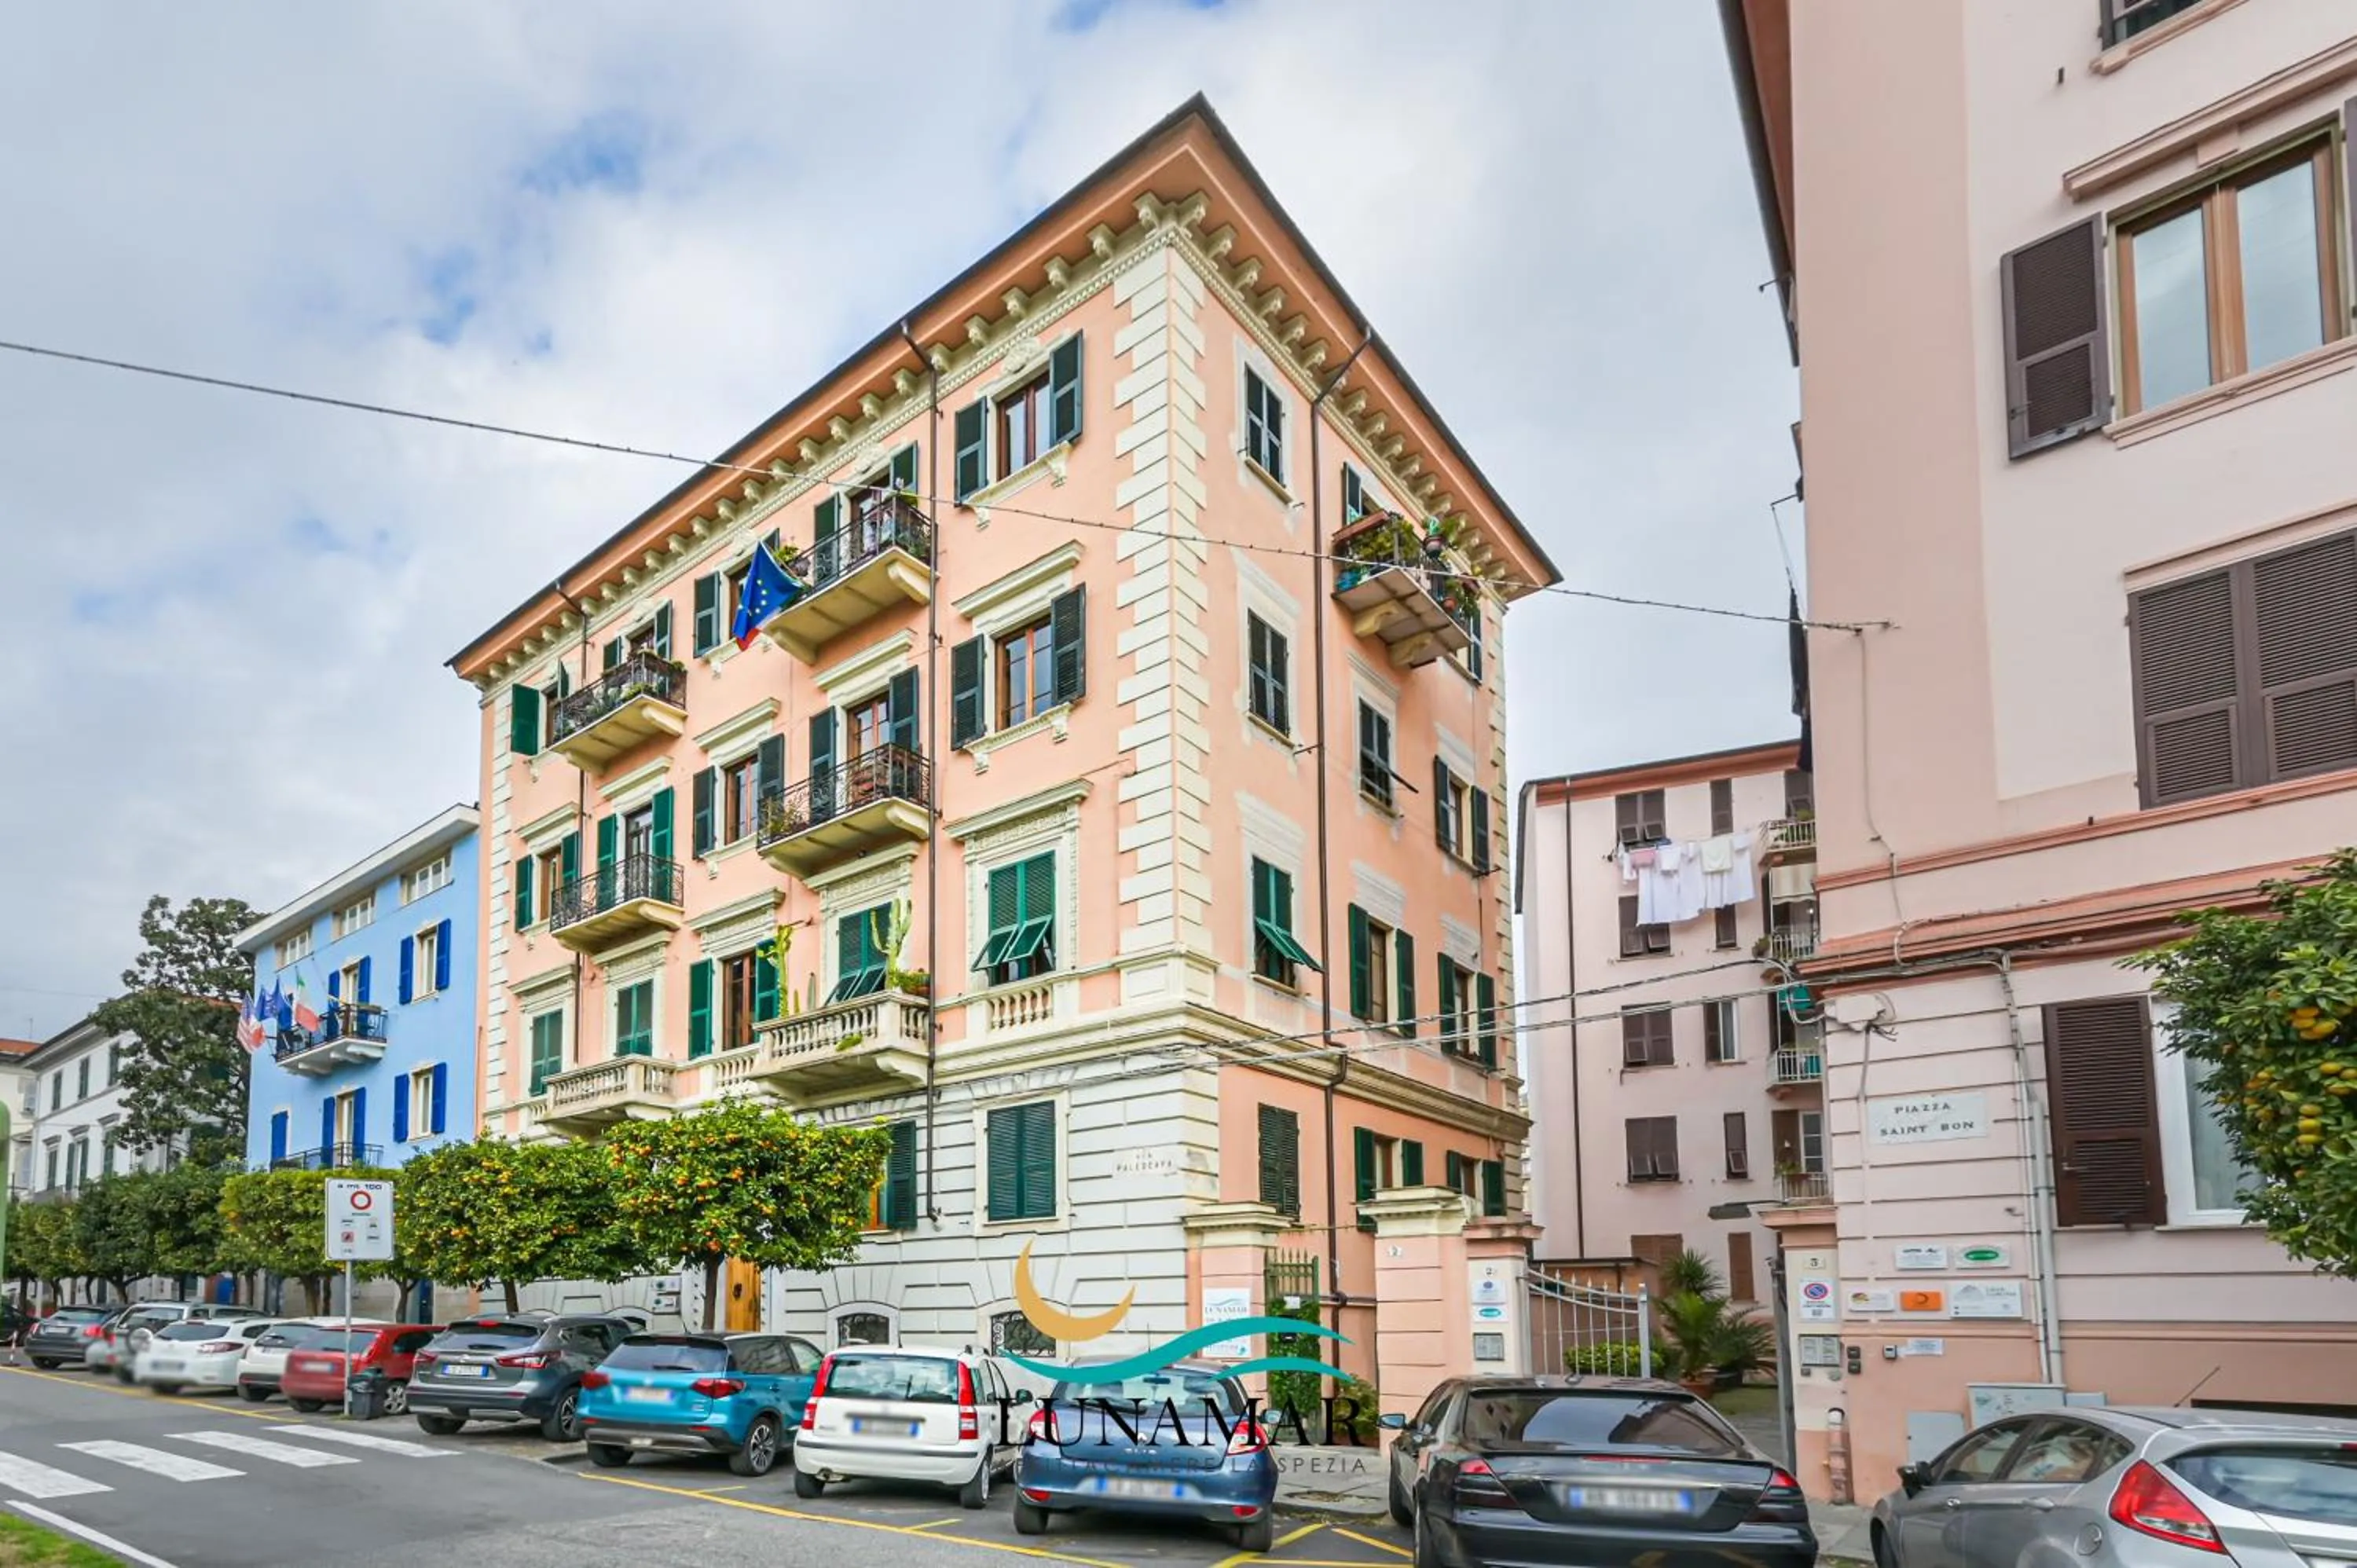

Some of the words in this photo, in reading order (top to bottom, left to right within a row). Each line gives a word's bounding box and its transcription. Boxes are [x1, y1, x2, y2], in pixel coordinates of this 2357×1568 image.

[1894, 1102, 1950, 1114] PIAZZA
[1880, 1125, 1927, 1136] SAINT
[1941, 1121, 1974, 1131] BON
